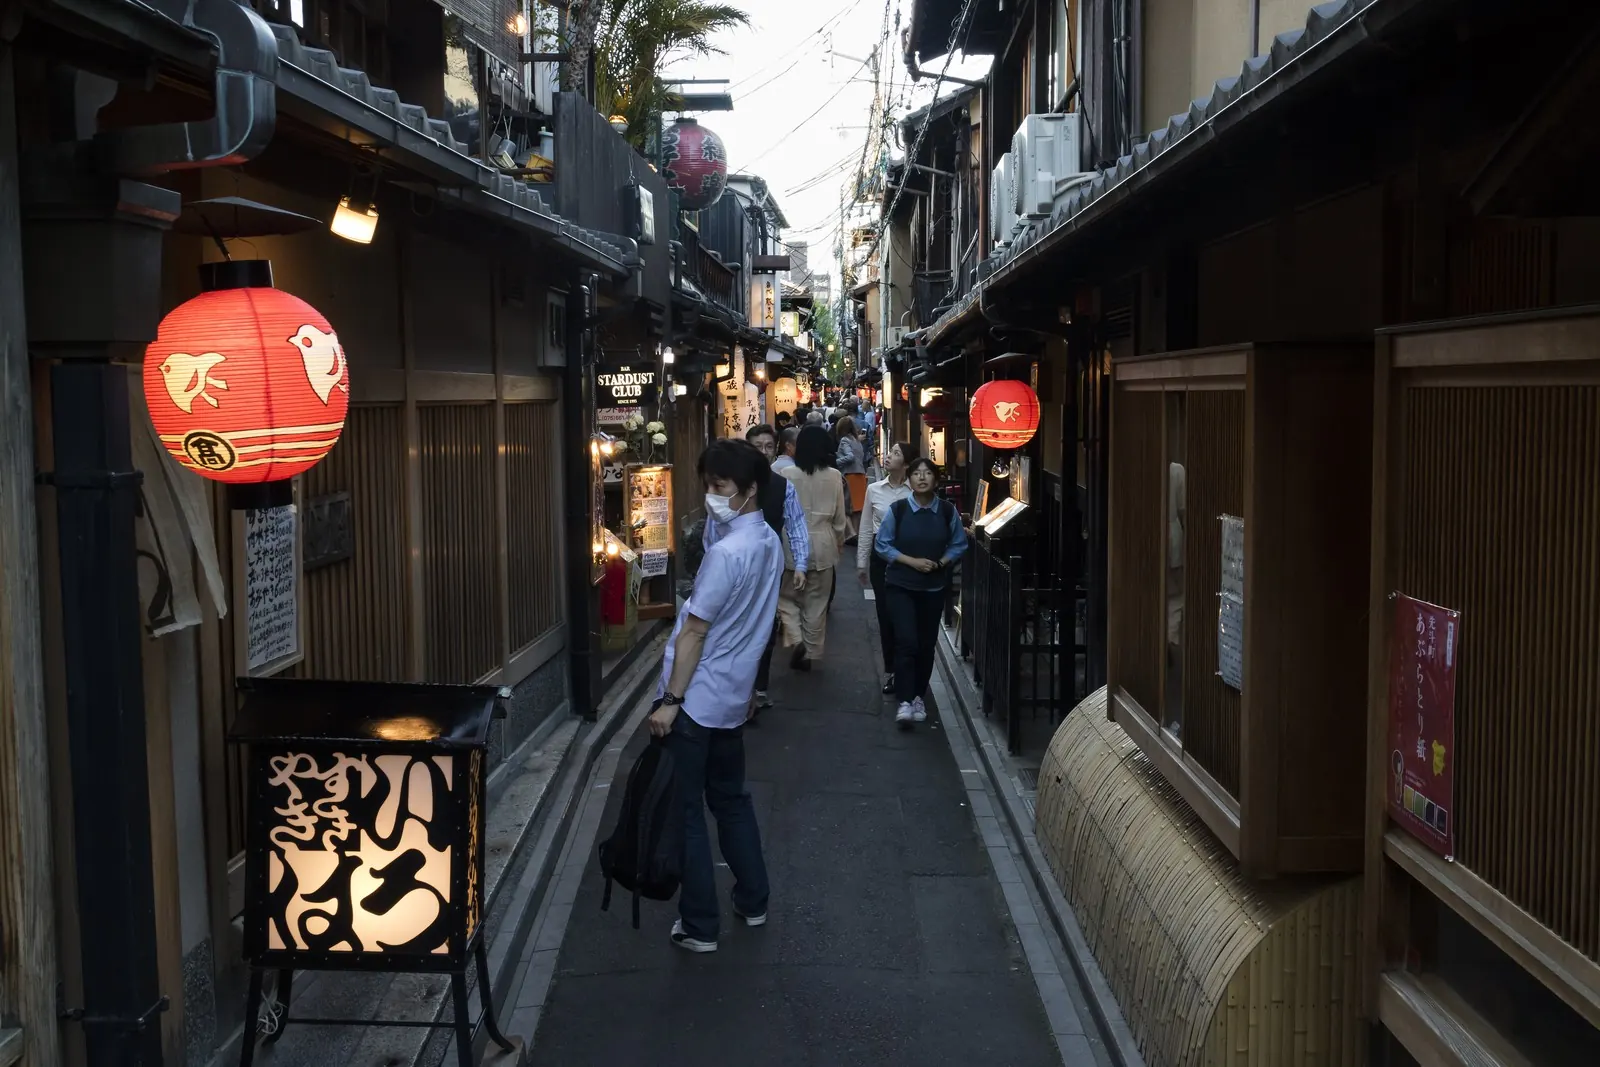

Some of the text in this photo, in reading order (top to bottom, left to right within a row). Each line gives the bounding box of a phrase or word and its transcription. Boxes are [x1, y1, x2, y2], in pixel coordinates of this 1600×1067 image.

[597, 372, 655, 386] STARDUST
[612, 385, 642, 397] CLUB
[1427, 615, 1437, 659] 先斗町
[1415, 612, 1427, 763] あぶらとり紙
